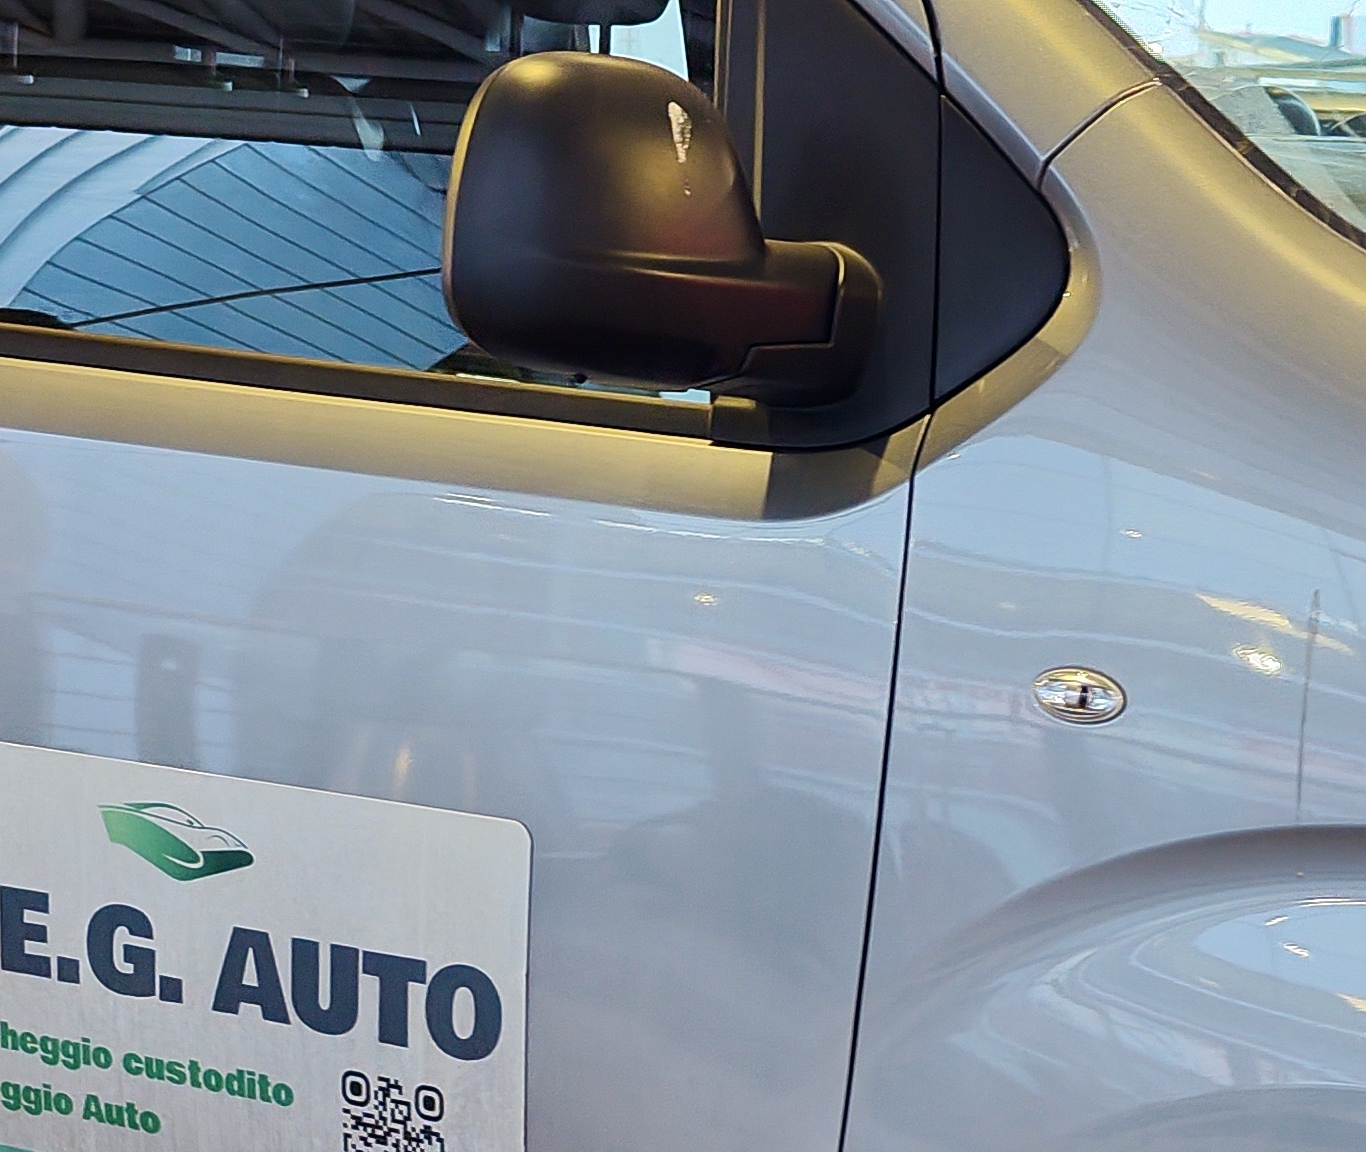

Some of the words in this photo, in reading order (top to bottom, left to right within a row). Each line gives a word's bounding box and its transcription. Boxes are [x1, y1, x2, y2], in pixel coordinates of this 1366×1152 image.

[211, 925, 503, 1062] AUTO
[122, 1051, 295, 1107] custodito
[81, 1093, 162, 1135] Auto
